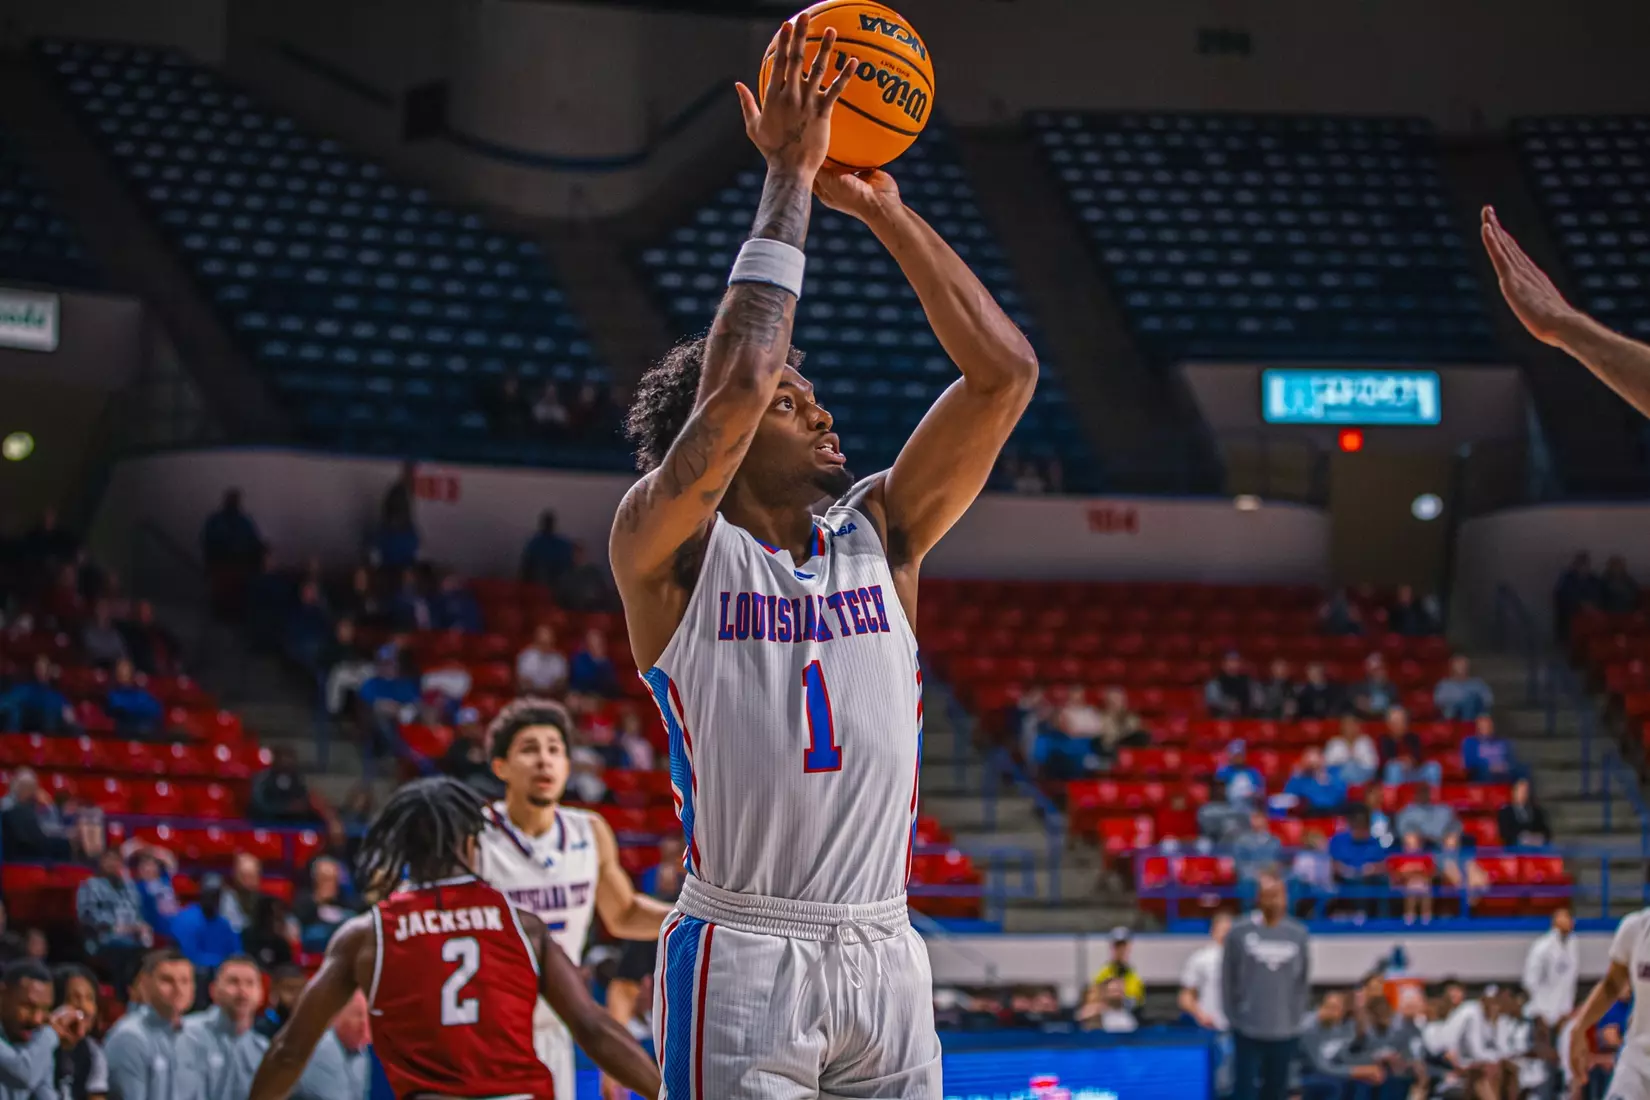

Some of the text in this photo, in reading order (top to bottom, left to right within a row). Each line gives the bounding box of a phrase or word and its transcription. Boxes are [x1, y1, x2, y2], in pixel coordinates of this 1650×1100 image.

[859, 13, 926, 61] NCAA
[880, 60, 896, 72] NXT
[826, 585, 890, 637] TECH
[802, 660, 842, 773] 1
[395, 906, 503, 942] JACKSON
[441, 936, 480, 1026] 2
